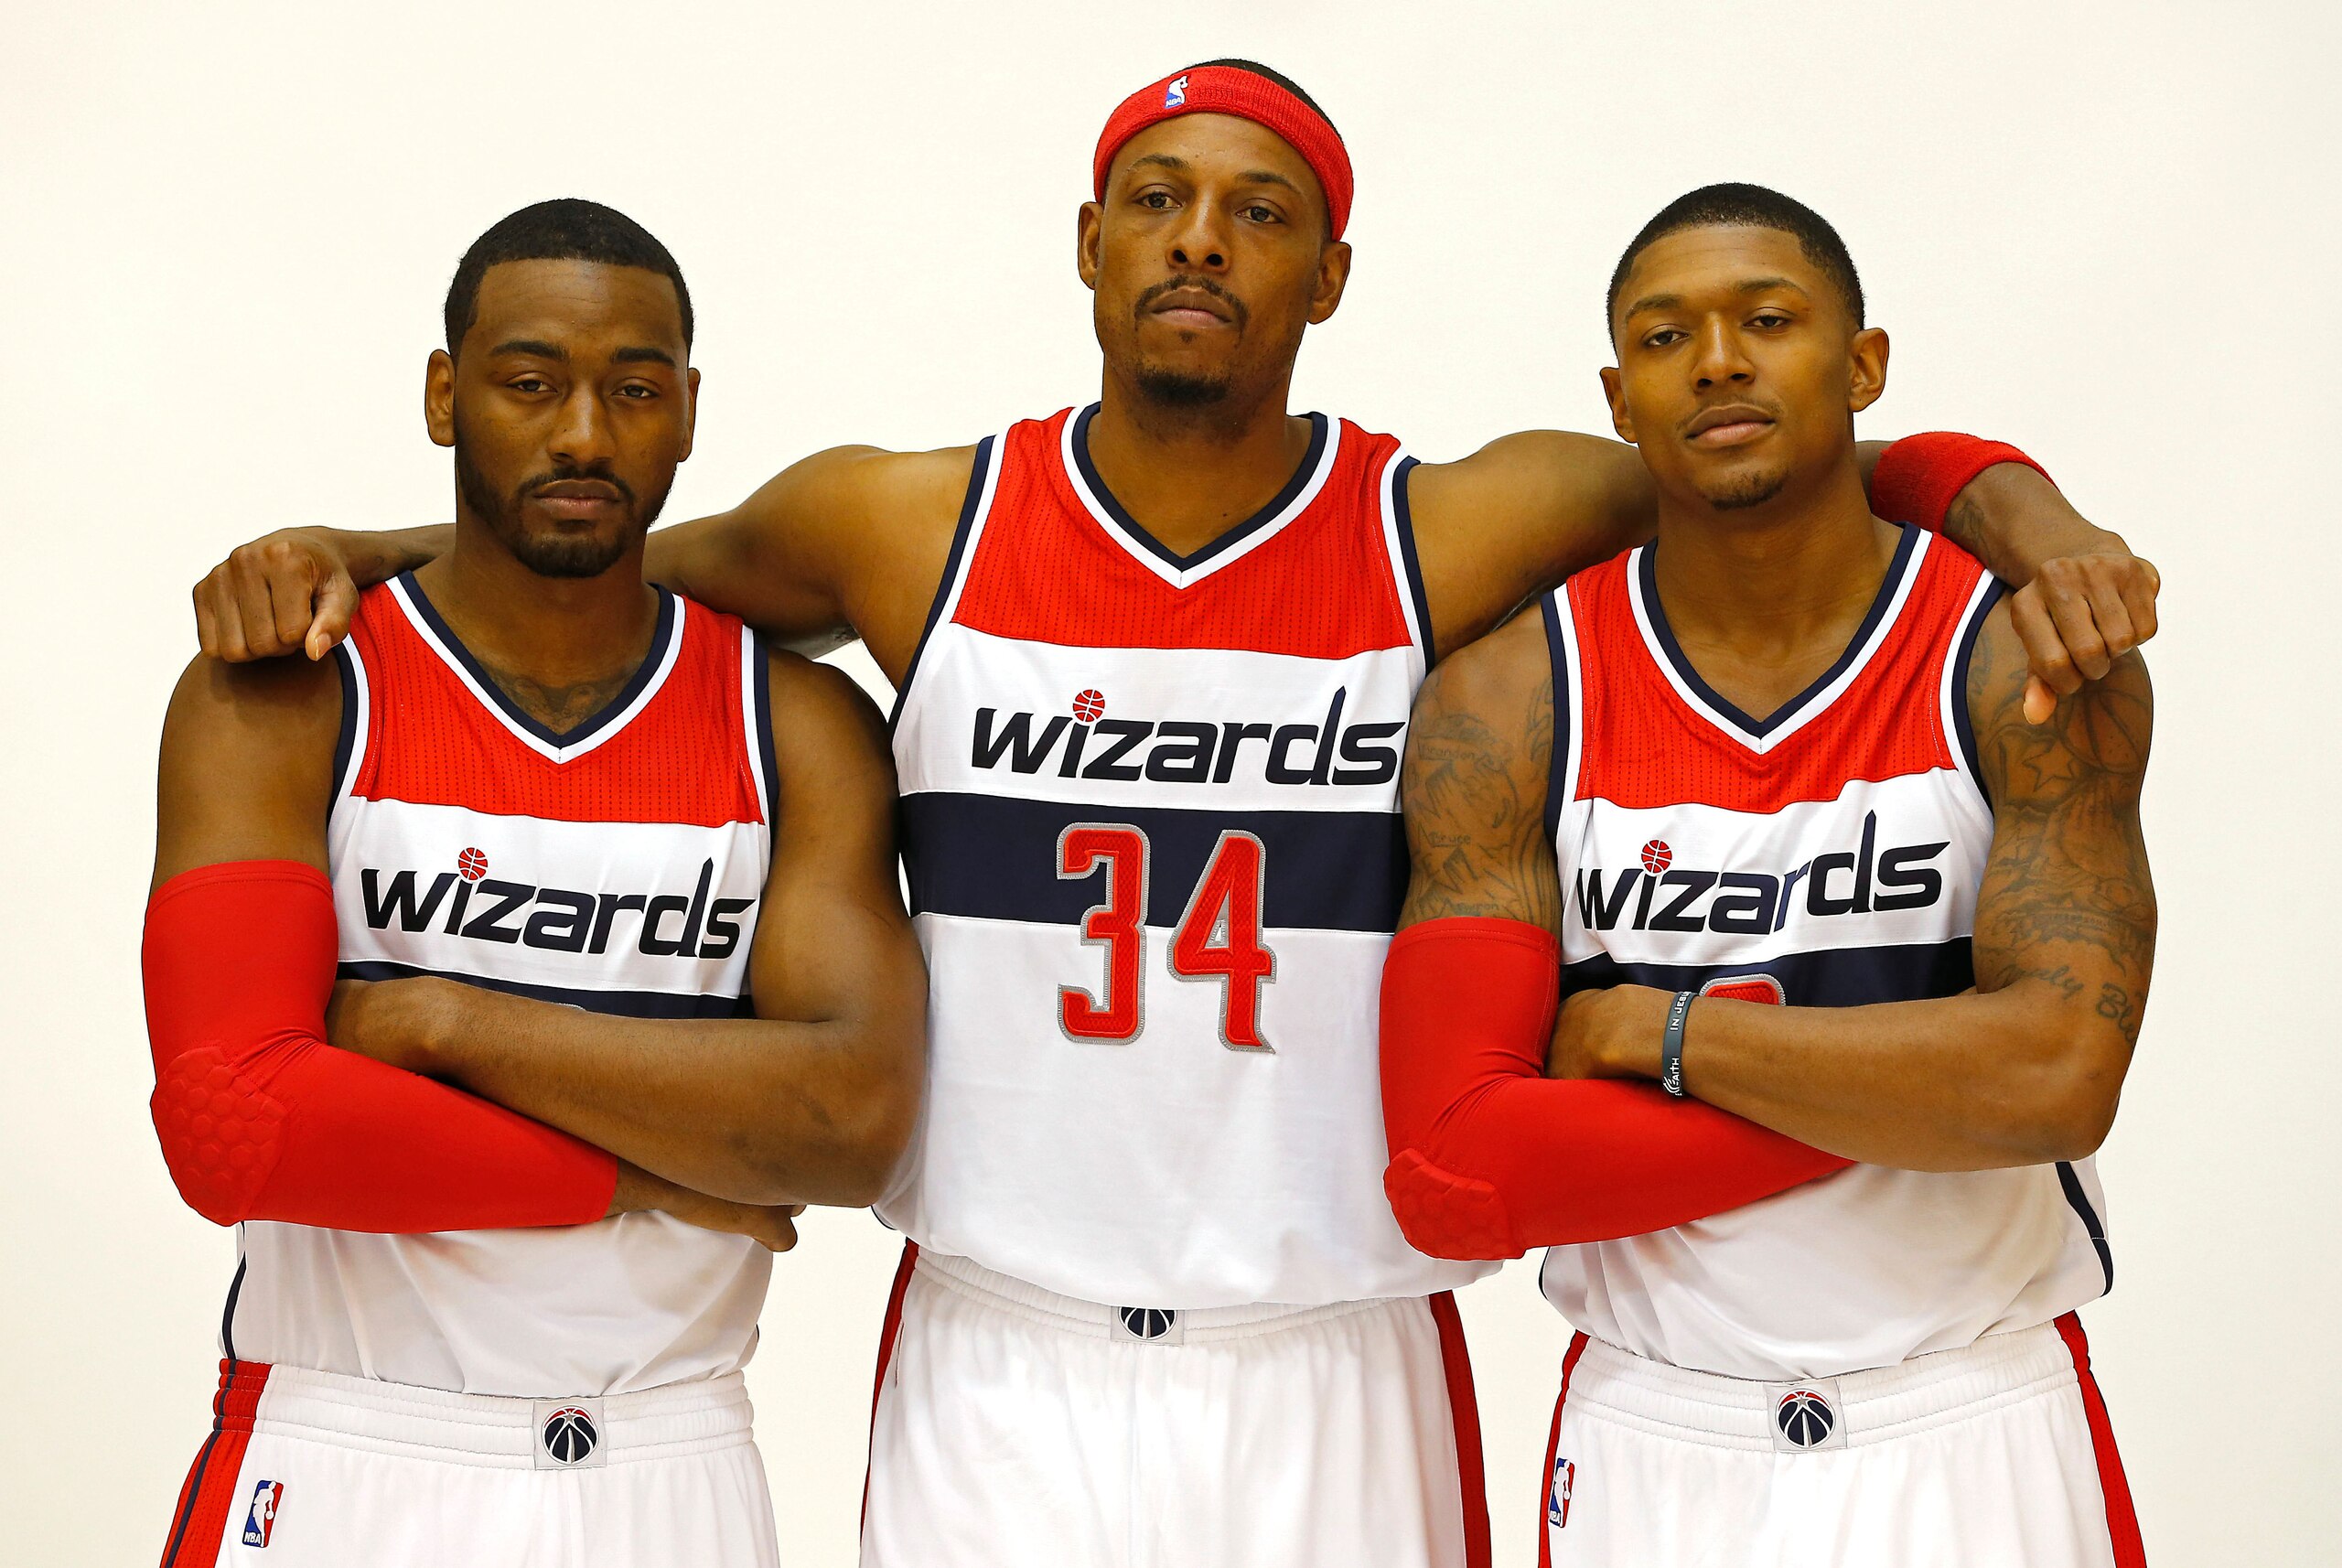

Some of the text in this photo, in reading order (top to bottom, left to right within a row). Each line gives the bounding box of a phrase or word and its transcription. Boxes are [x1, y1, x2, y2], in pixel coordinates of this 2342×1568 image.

[1166, 97, 1181, 107] NBA
[972, 685, 1406, 786] wizards
[360, 847, 756, 959] wizards
[1576, 810, 1950, 935] wizards
[1057, 822, 1277, 1054] 34
[1670, 1018, 1681, 1031] IN
[244, 1531, 261, 1544] NBA
